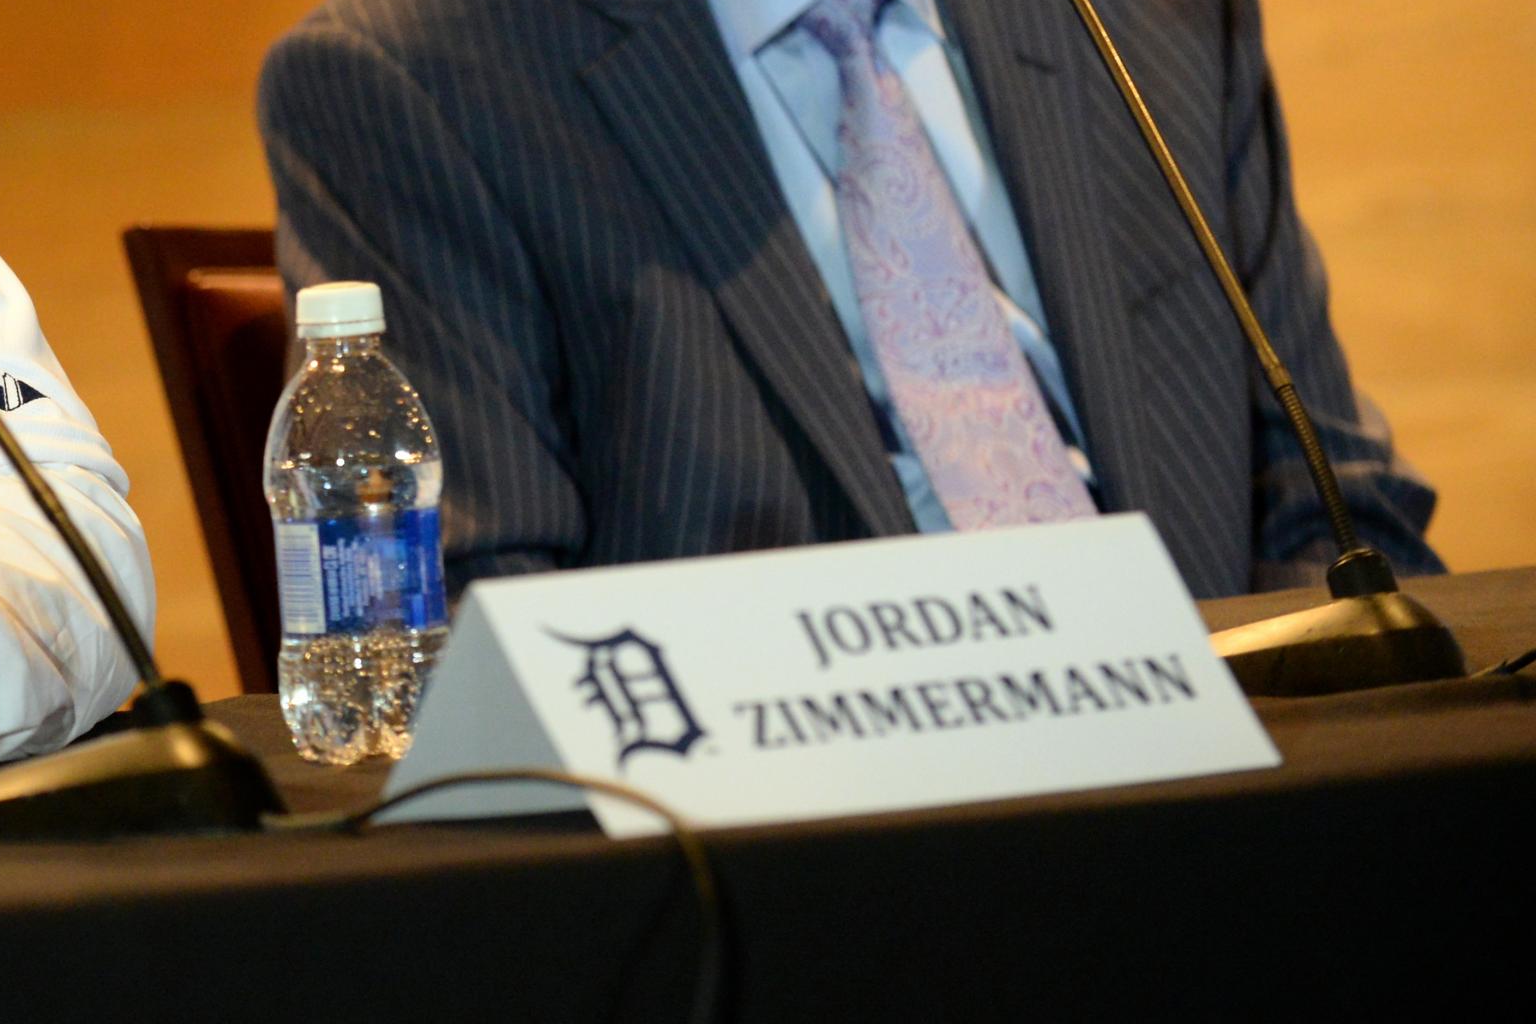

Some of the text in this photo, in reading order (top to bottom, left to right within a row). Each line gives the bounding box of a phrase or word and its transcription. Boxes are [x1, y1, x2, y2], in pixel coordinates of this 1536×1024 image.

[795, 584, 1055, 669] JORDAN
[538, 624, 707, 770] D
[734, 652, 1199, 750] ZIMMERMANN
